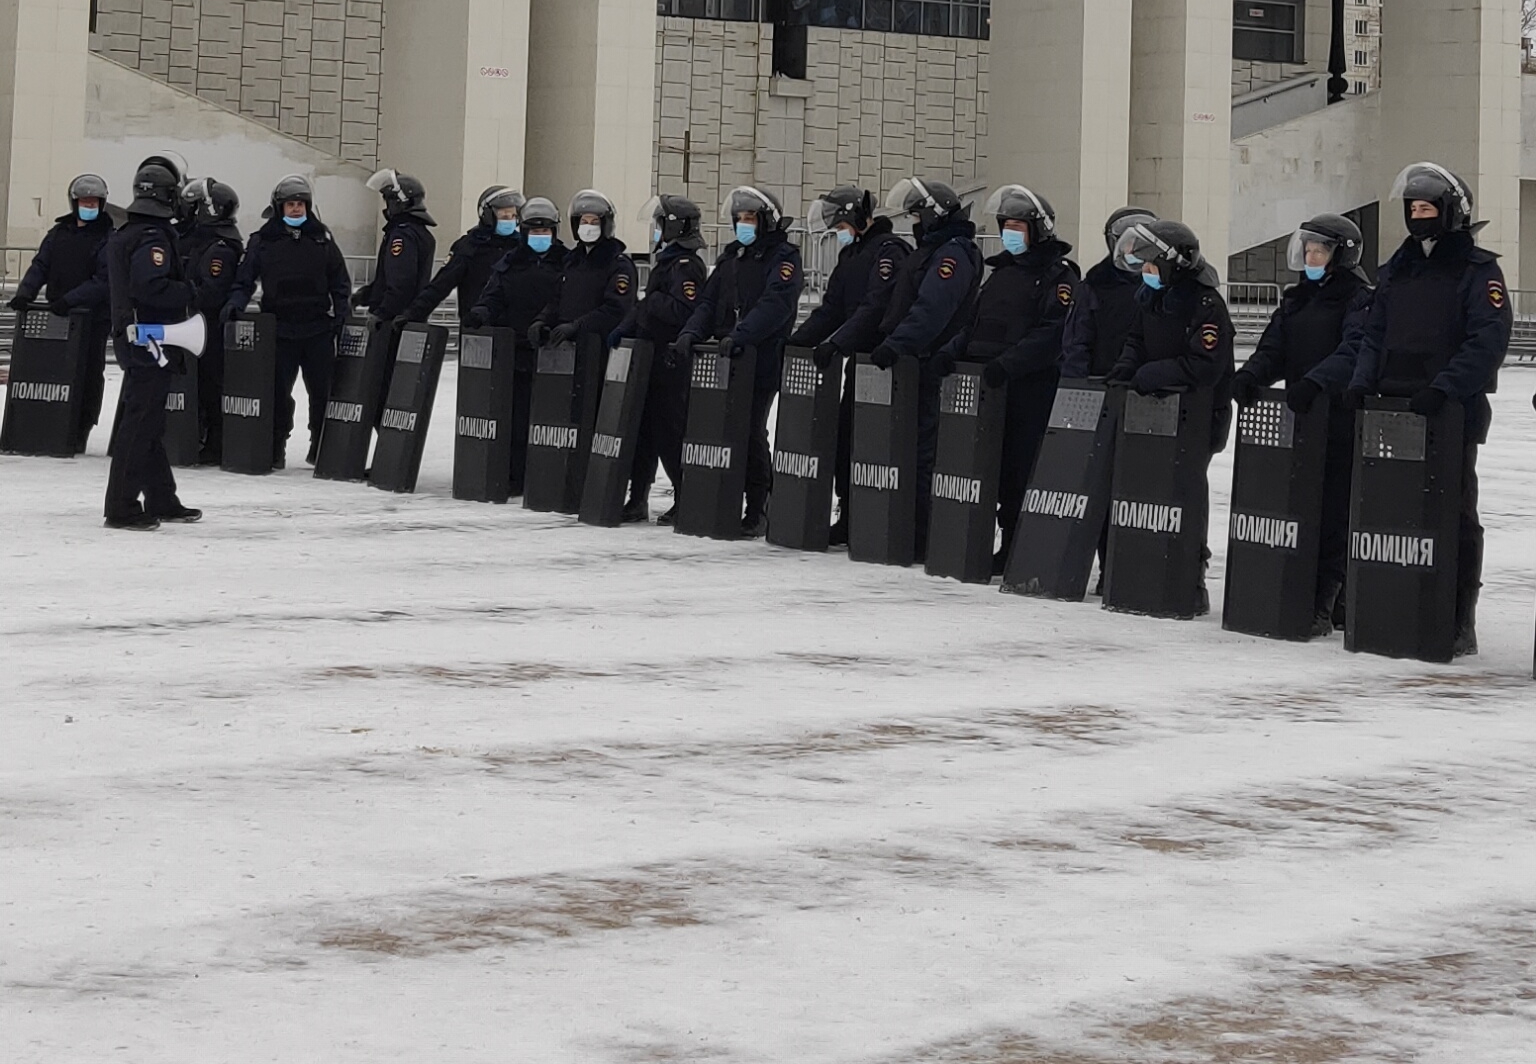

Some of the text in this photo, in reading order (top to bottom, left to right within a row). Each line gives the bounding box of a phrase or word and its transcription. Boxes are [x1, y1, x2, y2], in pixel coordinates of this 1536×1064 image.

[12, 382, 70, 403] ПОЛИЦИЯ
[1021, 489, 1089, 519] ПОЛИЦИЯ
[1112, 500, 1182, 533] ПОЛИЦИЯ
[1230, 513, 1298, 548] ПОЛИЦИЯ
[1352, 532, 1434, 566] ПОЛИЦИЯ
